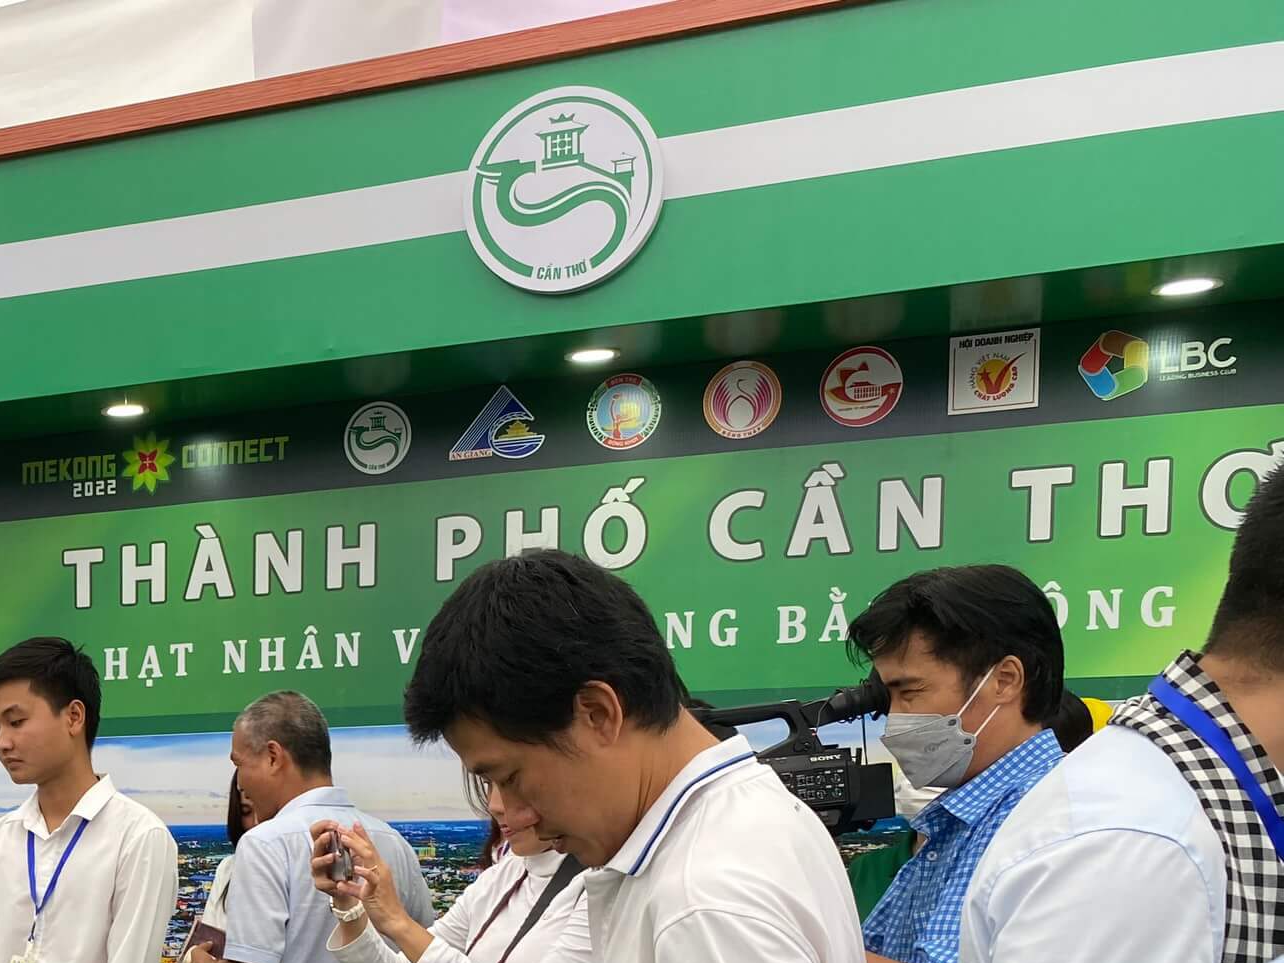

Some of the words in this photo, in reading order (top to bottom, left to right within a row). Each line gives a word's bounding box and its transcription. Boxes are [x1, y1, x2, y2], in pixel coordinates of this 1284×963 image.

[564, 259, 588, 279] THƠ
[958, 339, 973, 351] HỘI
[974, 336, 1003, 348] DOANH
[1004, 332, 1035, 345] NGHIỆP
[1159, 337, 1237, 374] LBC
[21, 454, 116, 485] MEKONG
[181, 436, 290, 469] CONNECT
[462, 448, 492, 460] GIANG
[72, 479, 117, 498] 2022
[62, 522, 378, 609] THÀNH
[435, 476, 647, 582] PHỐ
[708, 462, 945, 562] CẦN
[1009, 440, 1284, 542] THƠ
[103, 642, 194, 688] HẠT
[223, 625, 362, 675] NHÂN
[809, 754, 841, 763] SONY
